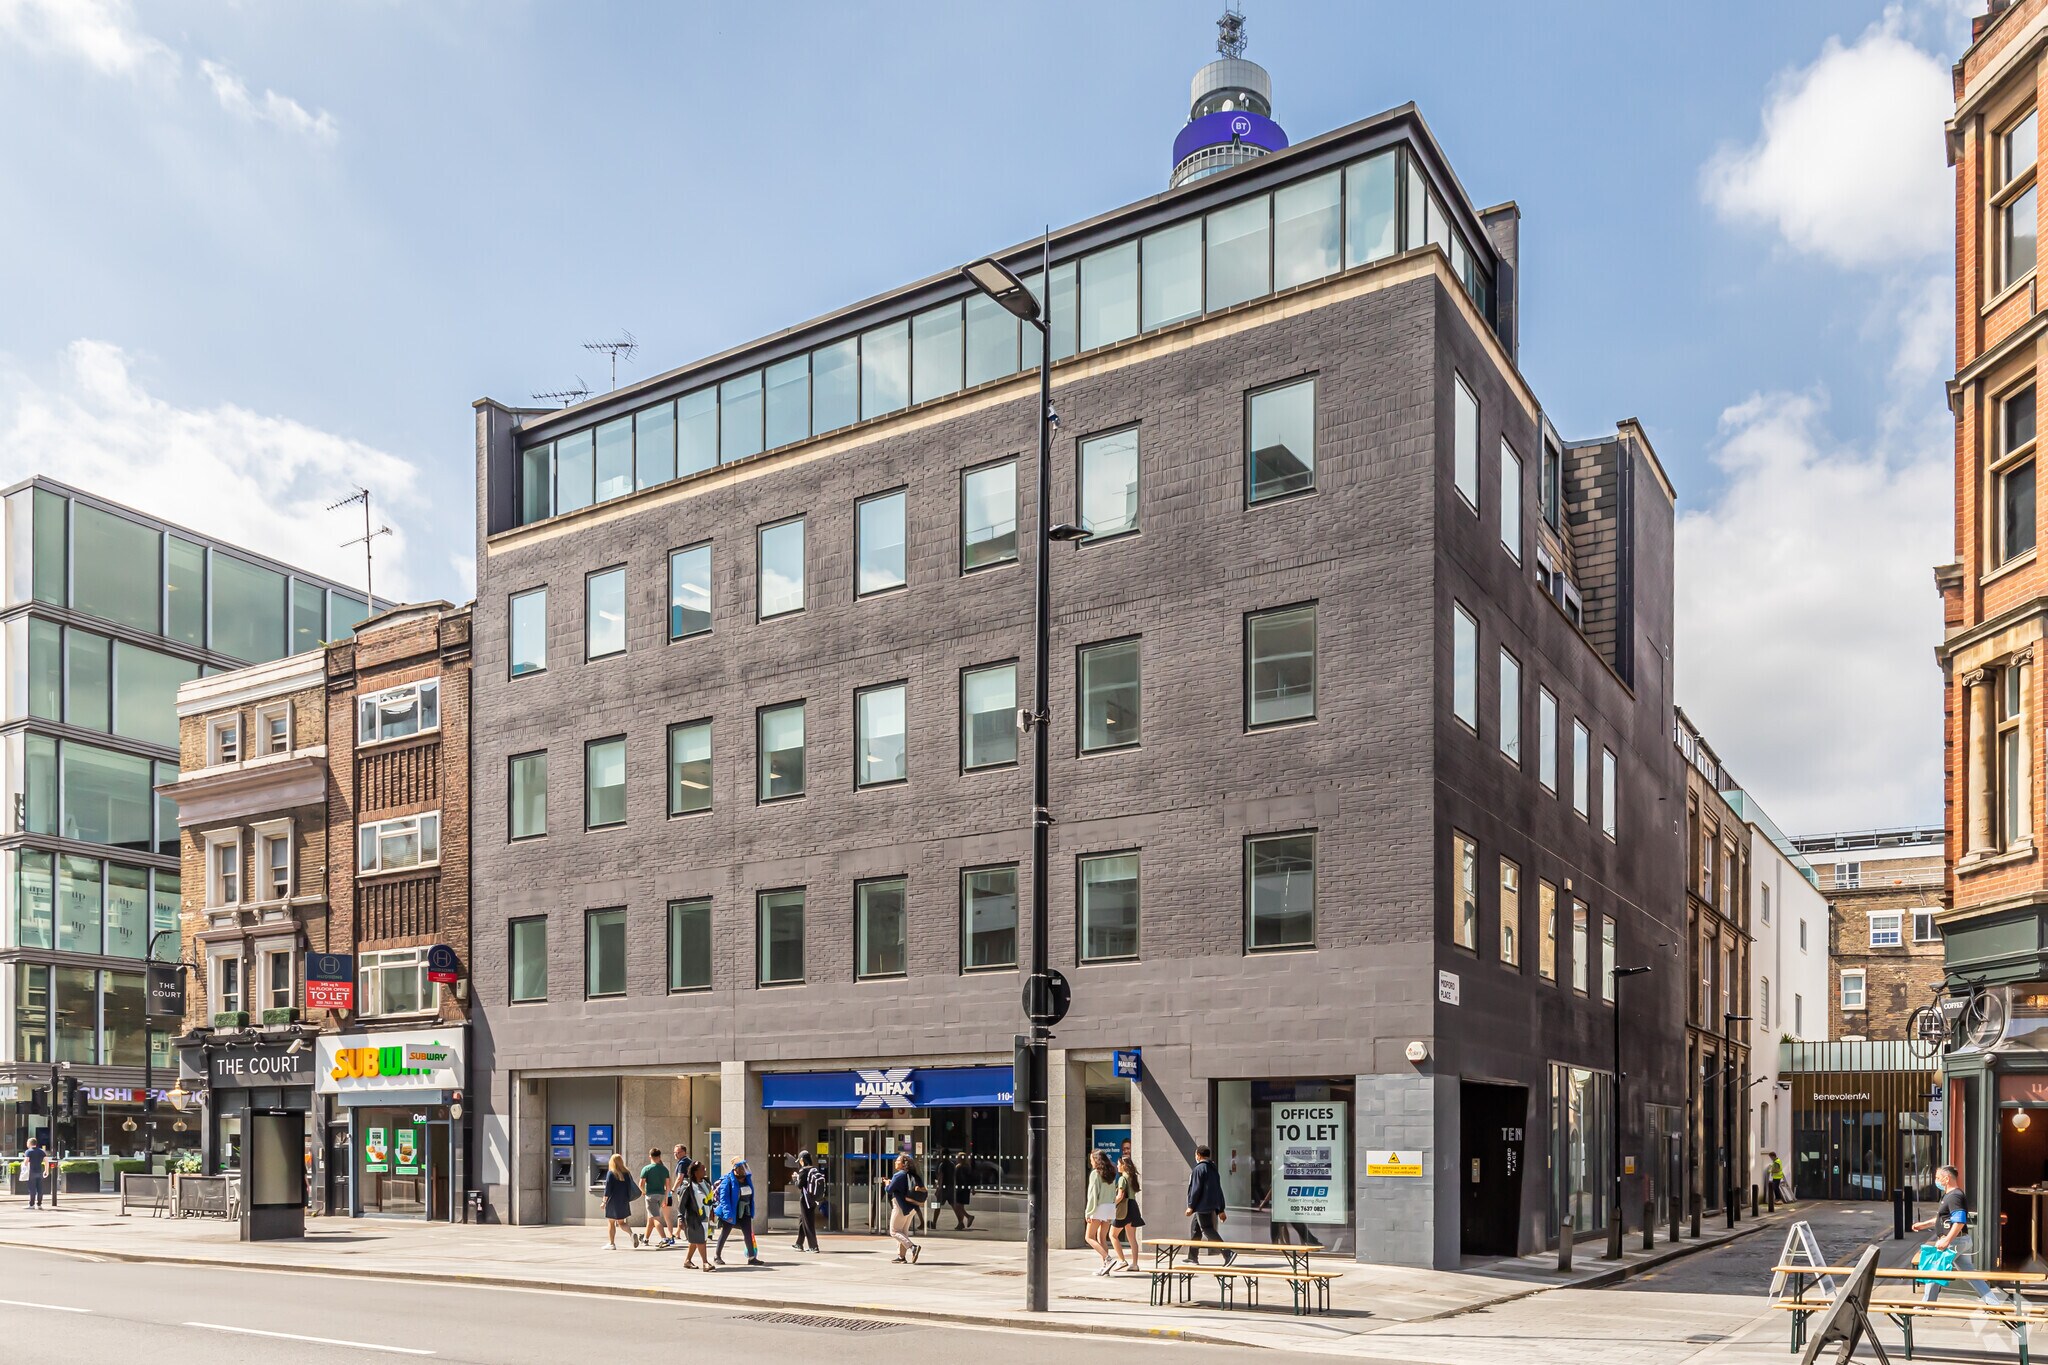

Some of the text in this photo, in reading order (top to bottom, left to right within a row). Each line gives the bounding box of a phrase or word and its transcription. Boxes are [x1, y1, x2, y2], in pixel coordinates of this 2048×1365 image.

[1440, 979, 1456, 990] MIDFORD
[310, 991, 349, 1000] TO LET
[1440, 990, 1451, 1000] PLACE
[1944, 1002, 1963, 1010] COFFEE
[409, 1052, 447, 1061] SUBWAY
[217, 1056, 300, 1075] THE COURT
[855, 1080, 914, 1096] HALIFAX
[1281, 1108, 1334, 1120] OFFICES
[1276, 1124, 1338, 1141] TO LET
[1502, 1128, 1522, 1141] TEN
[1289, 1187, 1327, 1197] RIB
